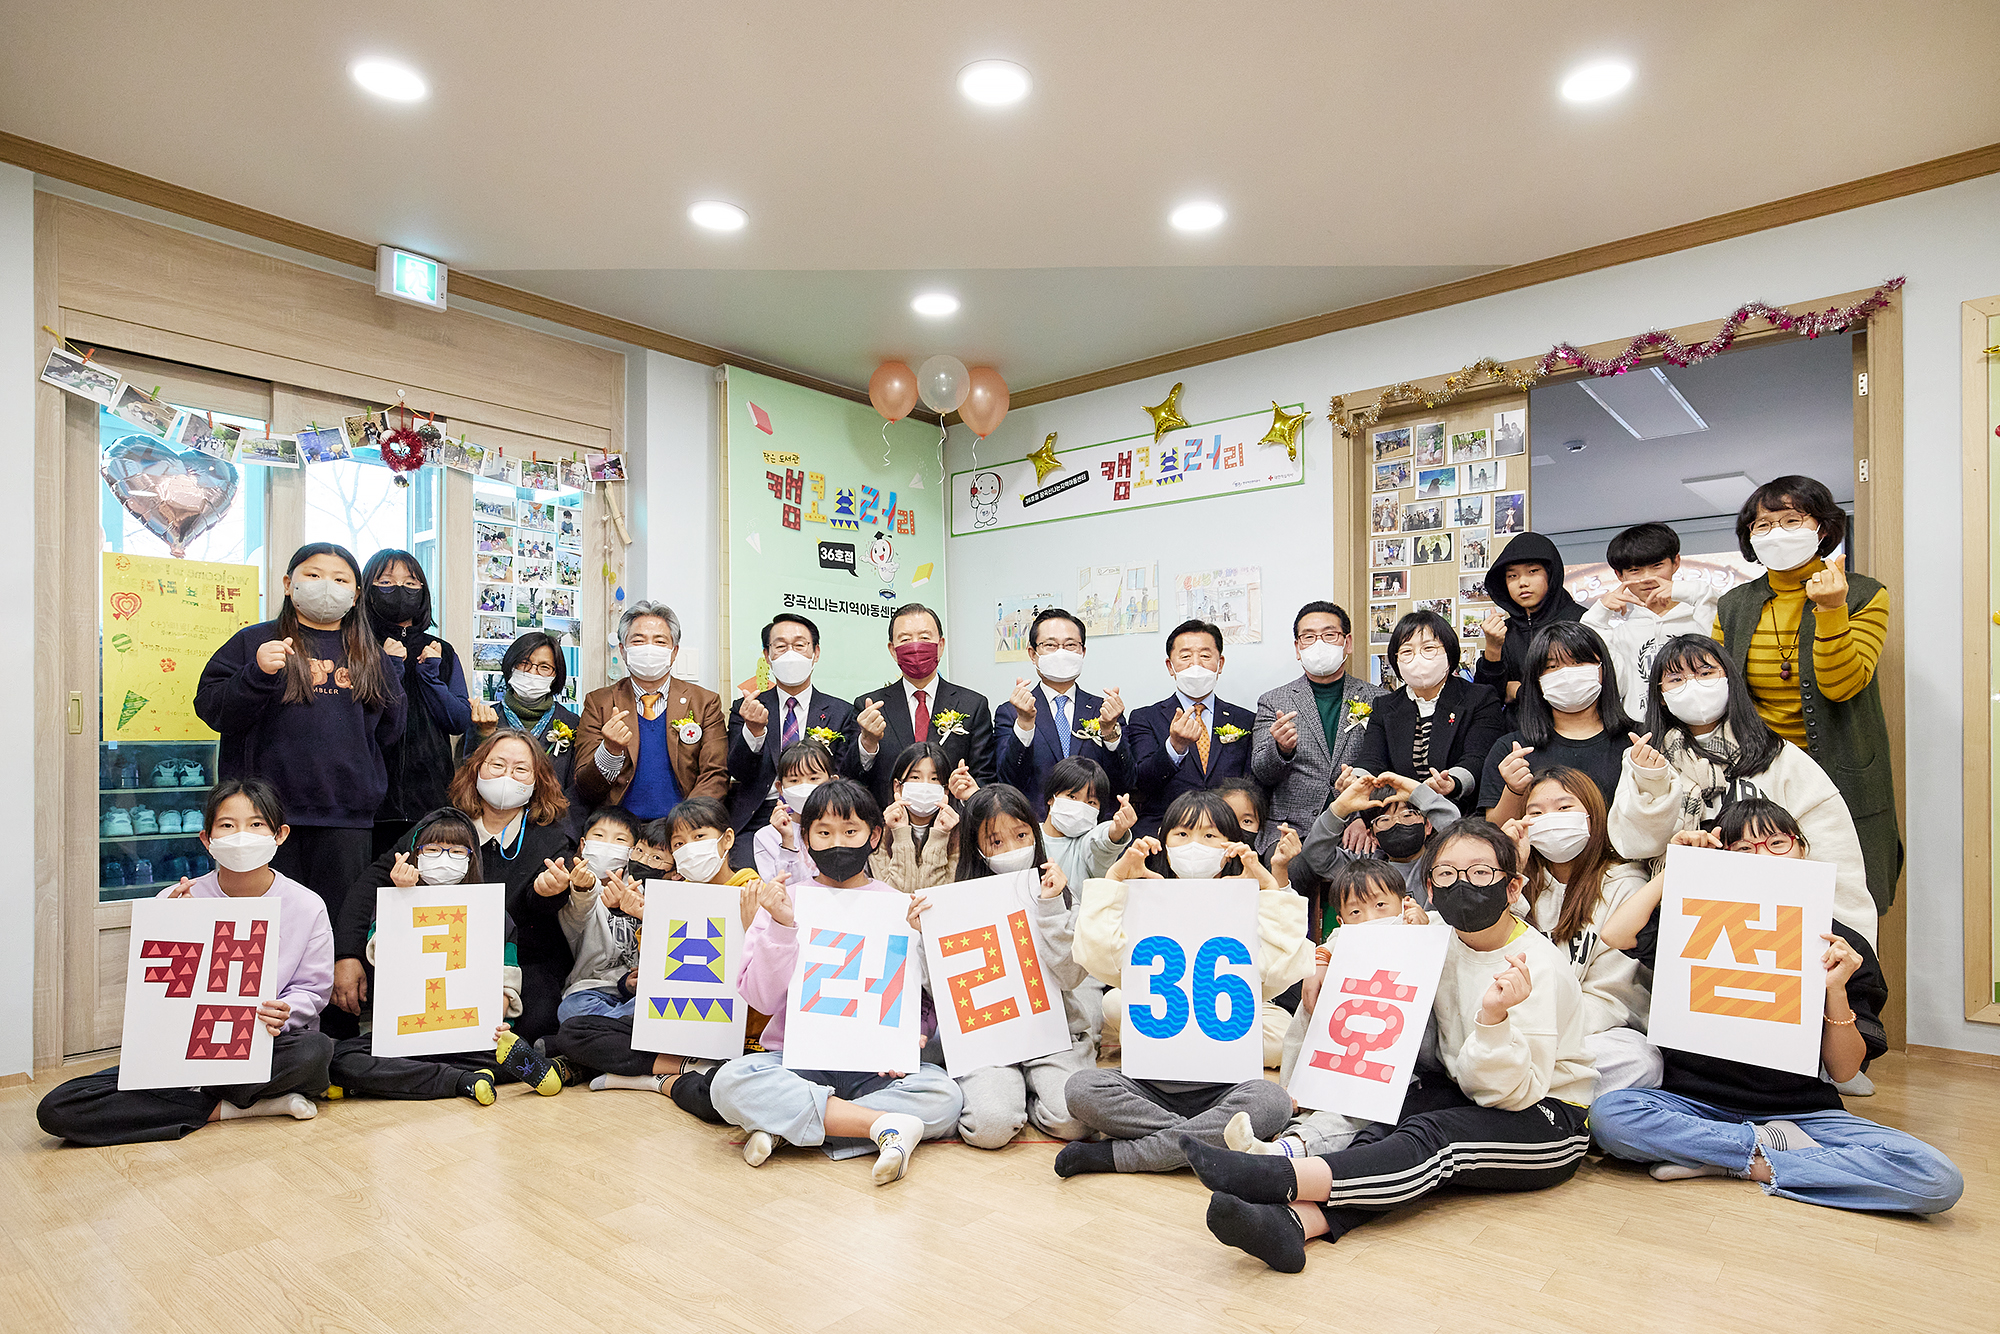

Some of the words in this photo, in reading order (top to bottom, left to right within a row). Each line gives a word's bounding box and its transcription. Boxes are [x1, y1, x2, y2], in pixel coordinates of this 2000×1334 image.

[765, 468, 916, 535] 캠코브러리
[779, 454, 799, 464] 도서관
[1100, 434, 1244, 501] 캠코브러리
[820, 546, 855, 564] 36호점
[140, 919, 268, 1060] 캠
[397, 904, 479, 1035] 코
[648, 917, 733, 1022] 브
[800, 927, 909, 1028] 러
[939, 909, 1052, 1034] 리
[1128, 935, 1255, 1041] 36
[1680, 897, 1803, 1026] 점
[1309, 969, 1417, 1084] 호
